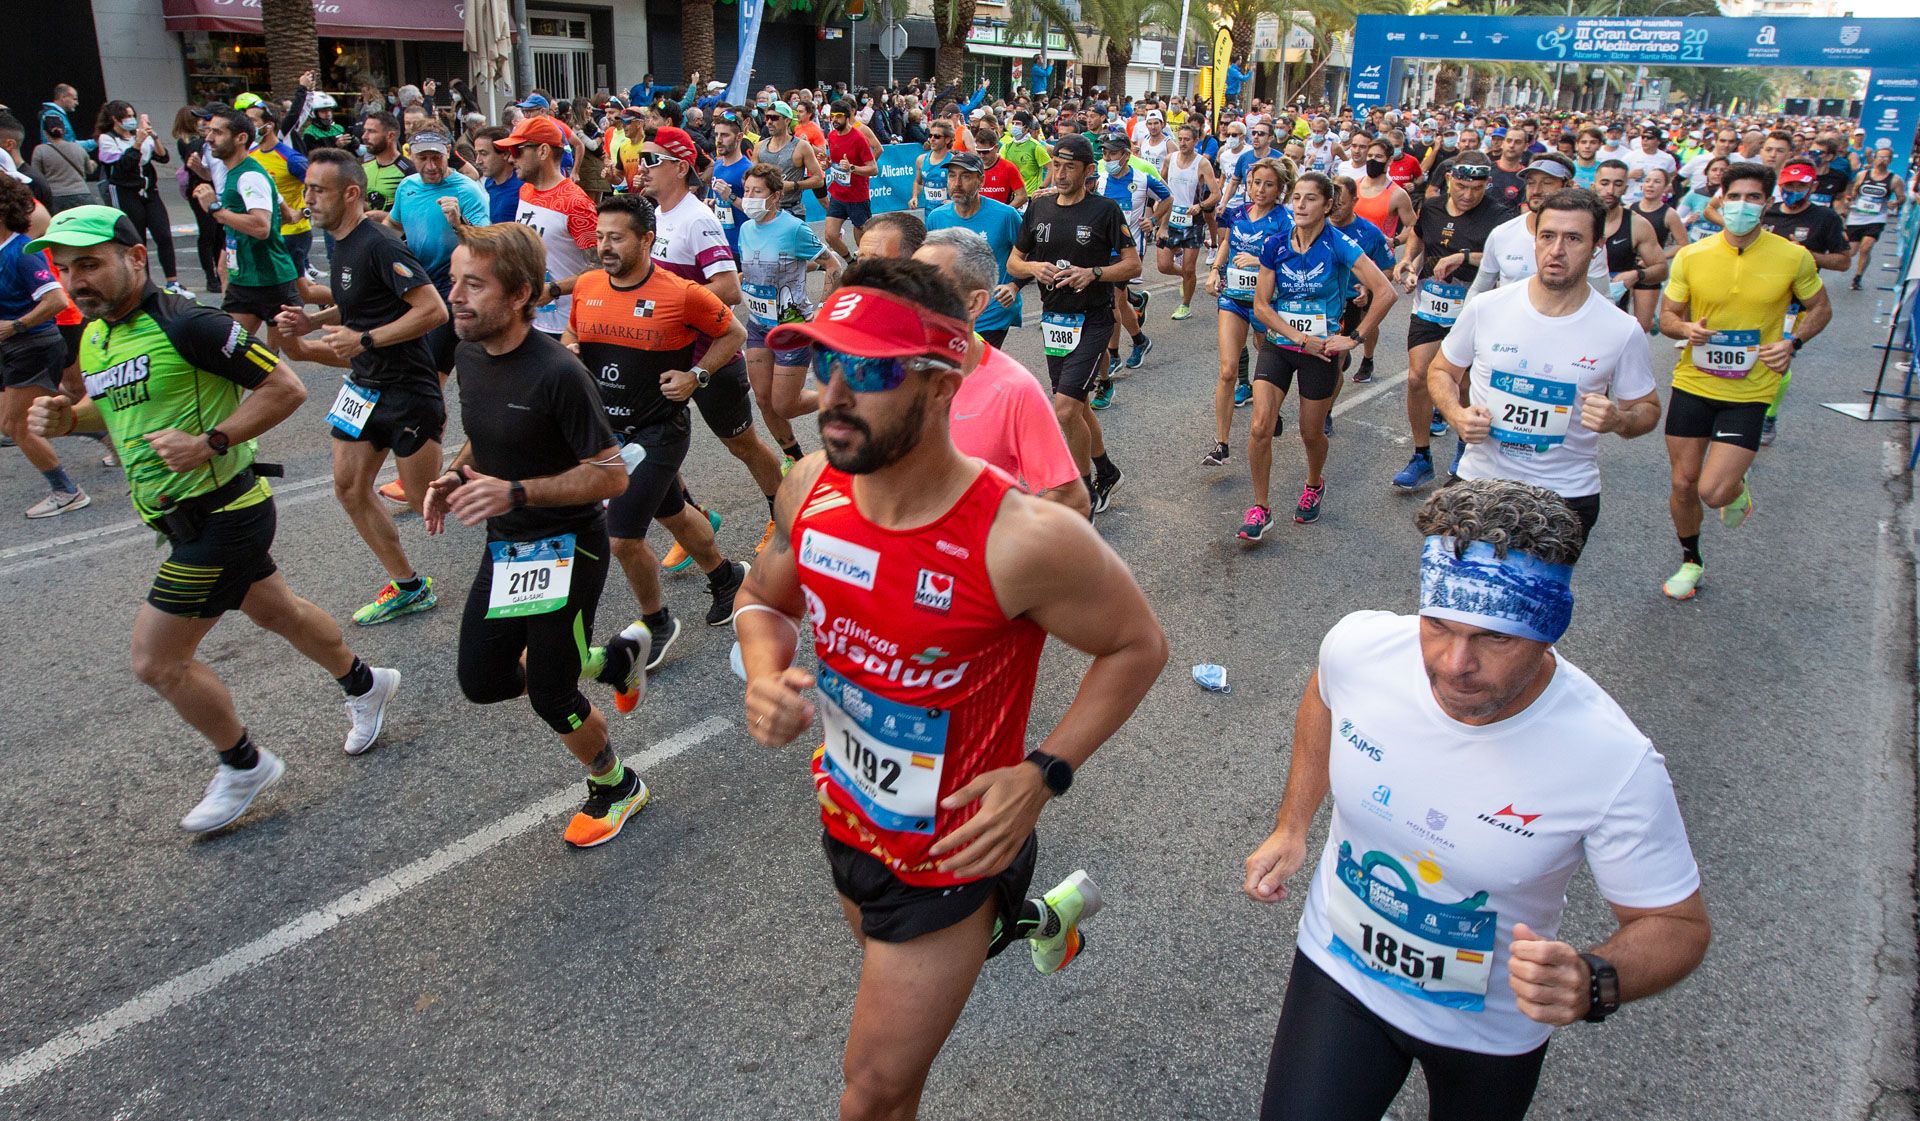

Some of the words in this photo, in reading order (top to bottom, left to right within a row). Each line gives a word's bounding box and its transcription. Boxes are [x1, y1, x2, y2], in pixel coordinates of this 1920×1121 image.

[1575, 27, 1591, 40] III
[1593, 27, 1627, 40] Gran
[1629, 27, 1681, 41] Carrera
[1683, 28, 1709, 45] 20
[1573, 40, 1594, 51] del
[1594, 40, 1679, 52] Mediterráneo
[1680, 45, 1705, 60] 21
[881, 164, 914, 178] Alicante
[1171, 215, 1187, 224] 2172
[1036, 222, 1052, 243] 21
[1239, 275, 1258, 286] 519
[1431, 300, 1449, 313] 149
[1289, 319, 1313, 332] 962
[1050, 330, 1073, 344] 2388
[1706, 350, 1746, 365] 1306
[1502, 403, 1549, 428] 2511
[508, 567, 551, 595] 2179
[921, 573, 928, 590] I
[916, 592, 951, 608] MOVE
[832, 616, 899, 657] Clínicas
[1348, 734, 1385, 762] AIMS
[842, 728, 902, 796] 1792
[1406, 820, 1455, 849] MONTEMAR
[1477, 813, 1536, 839] HEALTH
[1369, 879, 1396, 897] costa
[1359, 922, 1446, 981] 1851
